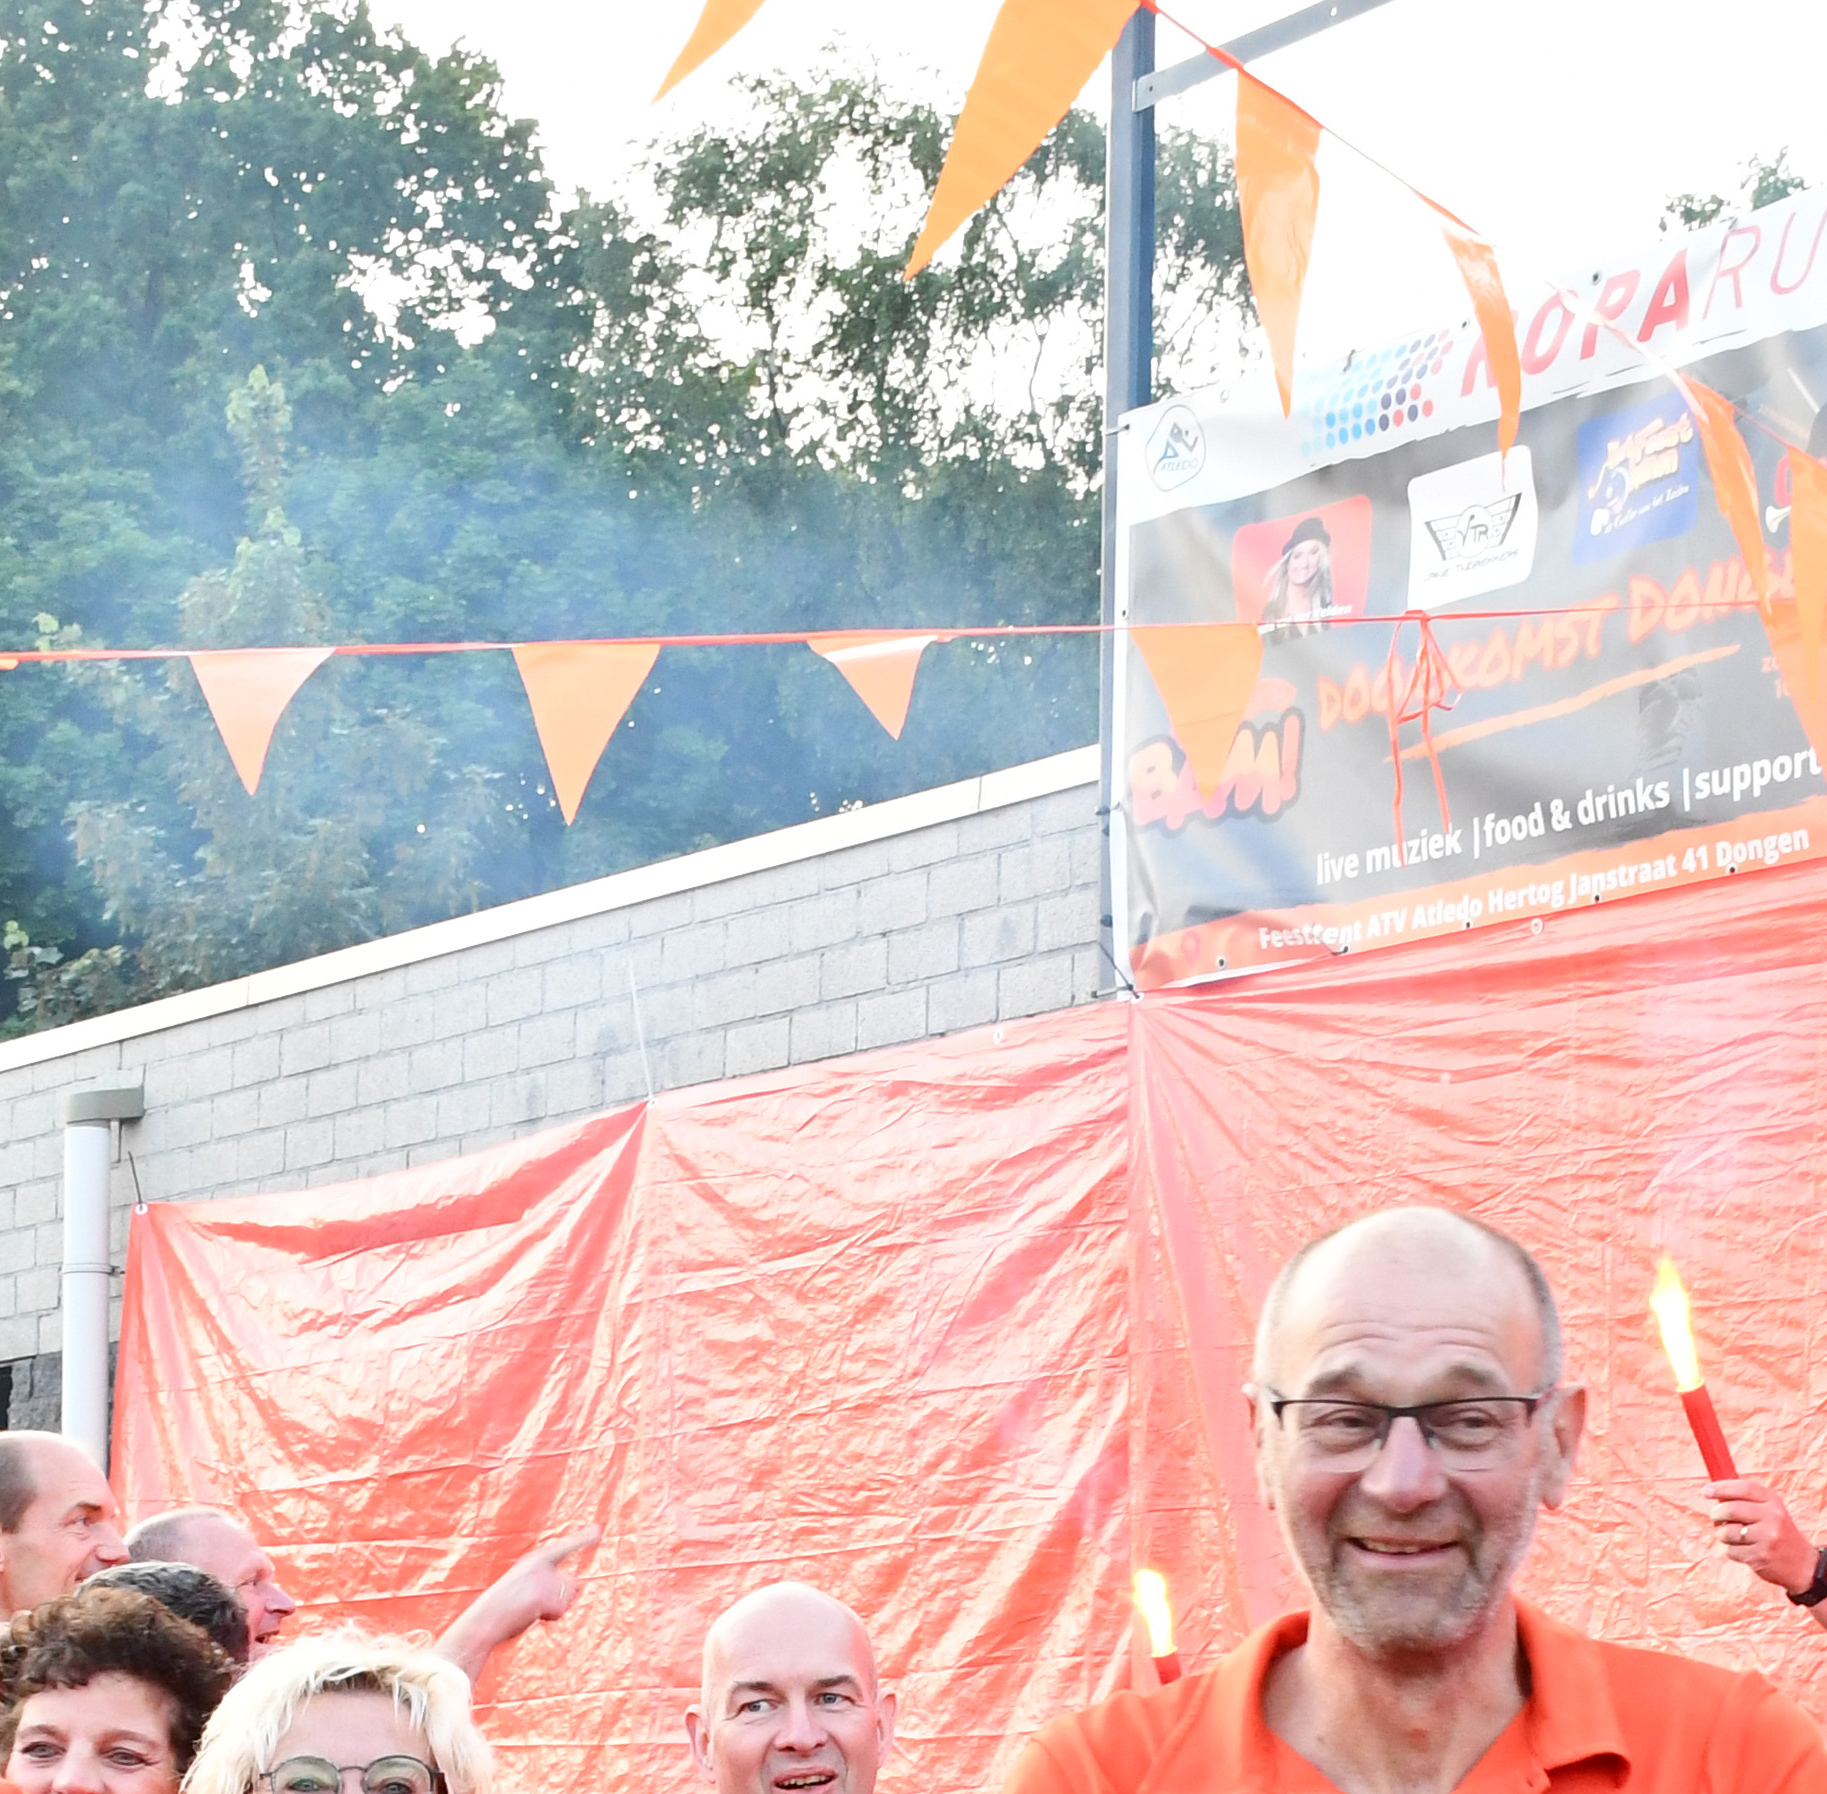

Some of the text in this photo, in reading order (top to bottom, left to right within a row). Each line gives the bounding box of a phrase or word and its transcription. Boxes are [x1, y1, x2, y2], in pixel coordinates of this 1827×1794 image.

[1259, 828, 1810, 950] Feesttent ATV Atledo Hertog Janstraat 41 Dongen
[1316, 852, 1360, 886] live
[1366, 822, 1463, 875] muziek
[1550, 798, 1573, 833] &
[1577, 777, 1671, 826] drinks
